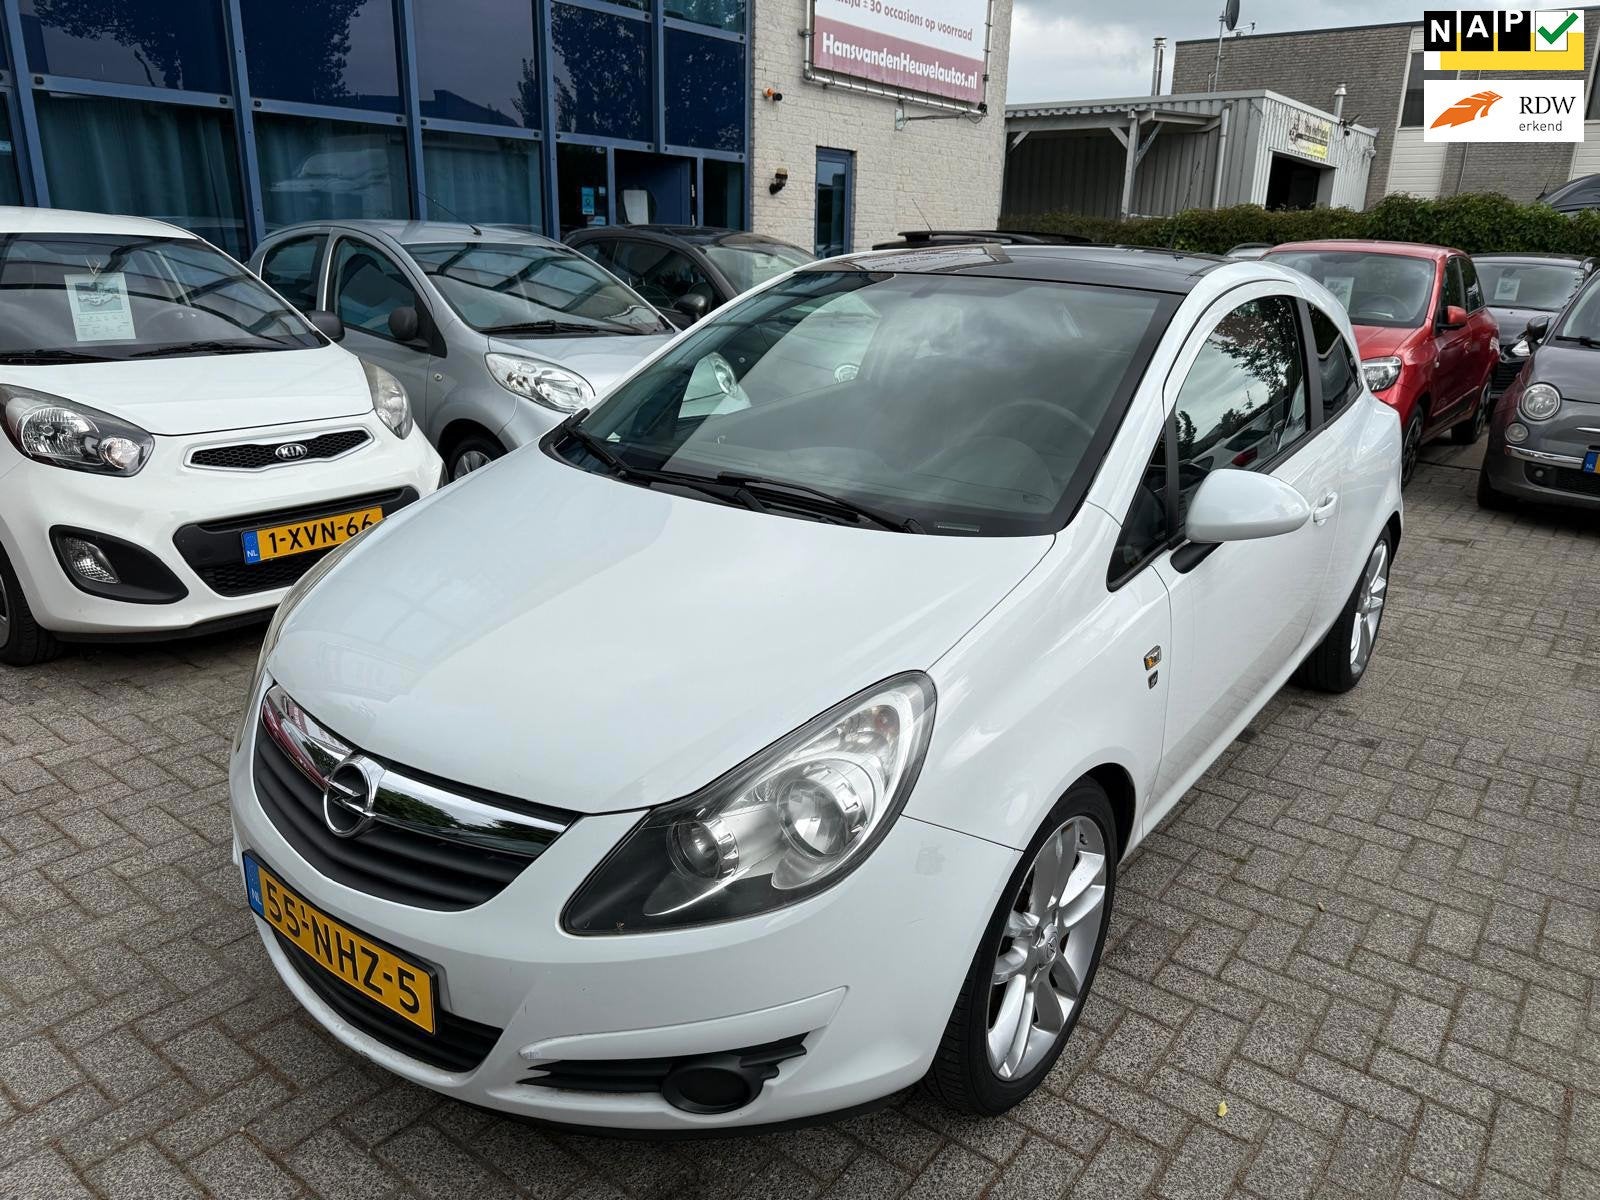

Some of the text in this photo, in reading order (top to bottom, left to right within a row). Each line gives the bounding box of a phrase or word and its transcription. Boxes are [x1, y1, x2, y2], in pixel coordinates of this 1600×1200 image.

[870, 0, 882, 14] 30
[884, 6, 923, 27] occasions
[925, 17, 935, 32] op
[937, 22, 973, 41] voorraad
[822, 32, 978, 90] HansvandenHeuvelautos.nl
[280, 445, 304, 457] KIA
[251, 879, 420, 1013] NL 55-NHZ-5
